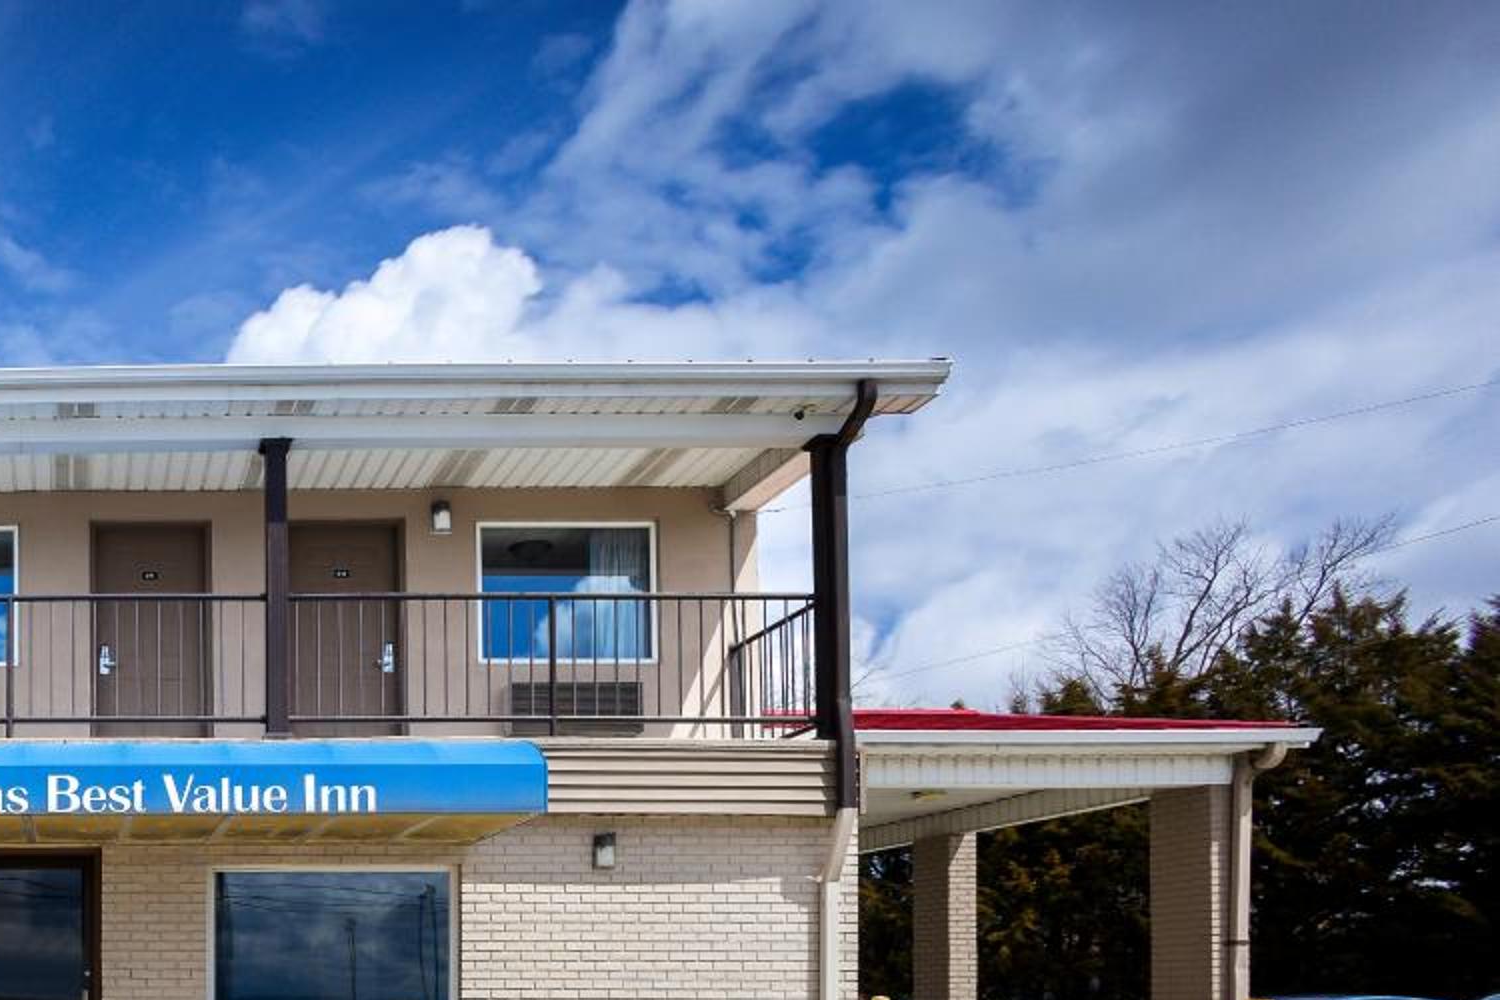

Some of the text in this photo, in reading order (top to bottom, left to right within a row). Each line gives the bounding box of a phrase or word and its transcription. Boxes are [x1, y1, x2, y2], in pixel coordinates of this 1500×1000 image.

[47, 774, 146, 814] Best
[163, 773, 287, 813] Value
[304, 773, 377, 812] Inn
